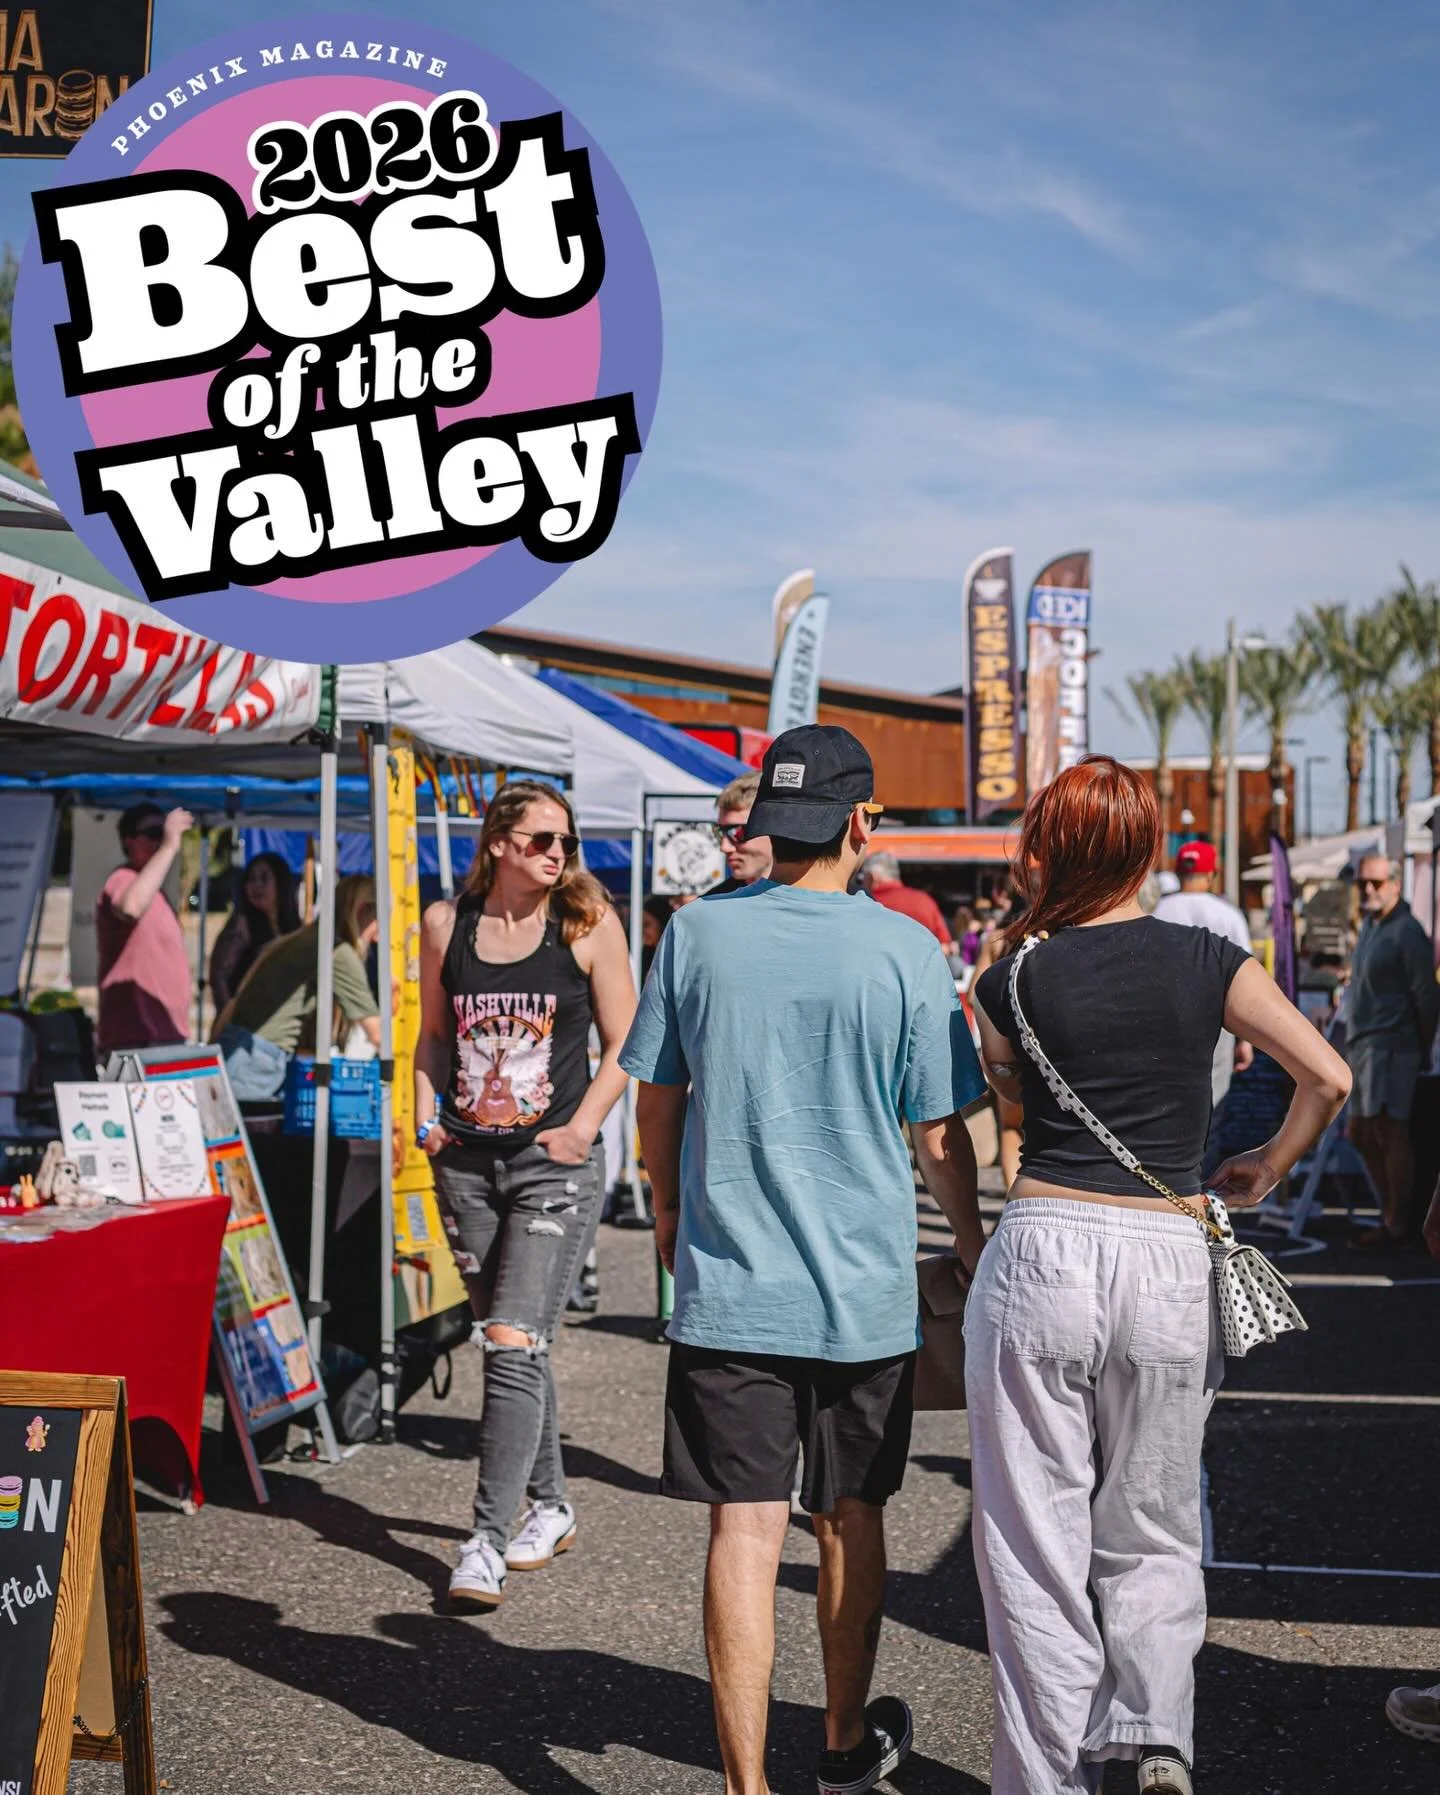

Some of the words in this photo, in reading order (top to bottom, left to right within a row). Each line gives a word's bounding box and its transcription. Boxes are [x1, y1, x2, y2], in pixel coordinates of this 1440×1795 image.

[0, 9, 44, 71] A
[788, 625, 817, 718] ENERGY
[973, 604, 1018, 801] ESPRESSO
[453, 993, 557, 1036] NASHVILLE
[0, 1564, 53, 1626] fted
